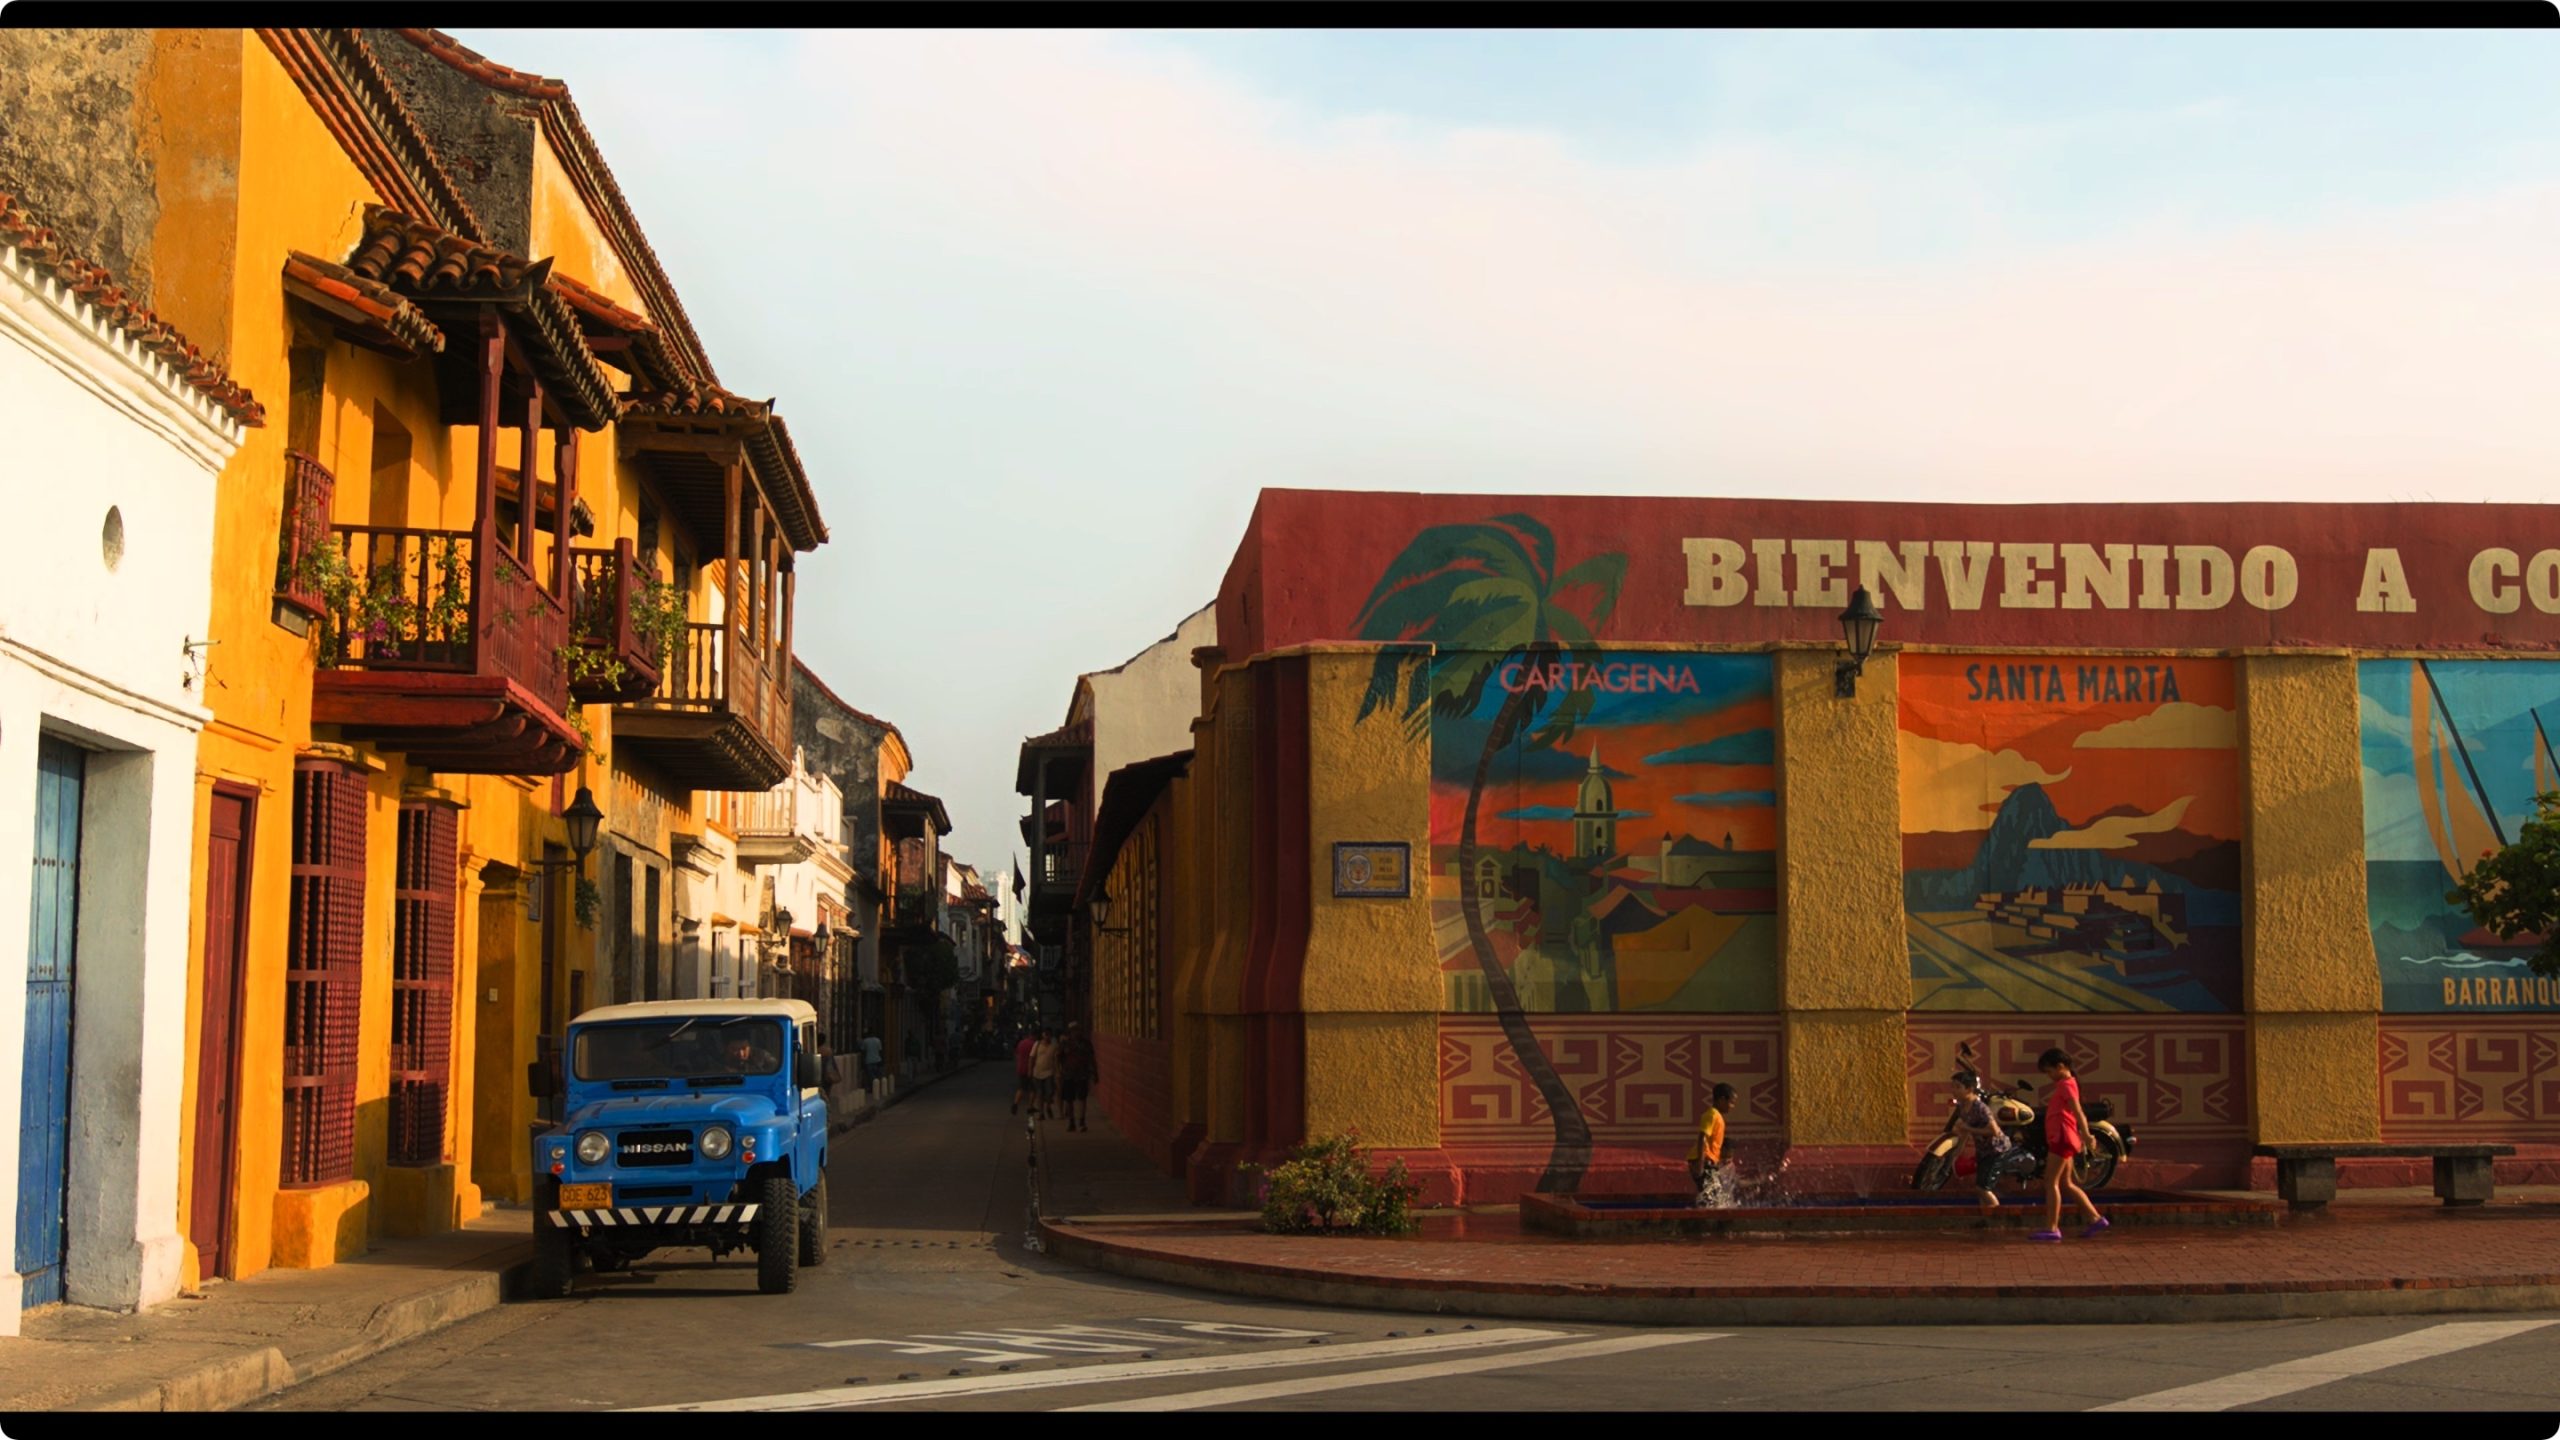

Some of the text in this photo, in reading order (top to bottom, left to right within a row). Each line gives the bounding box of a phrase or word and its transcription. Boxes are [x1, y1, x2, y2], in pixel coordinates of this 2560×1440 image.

[1683, 538, 2299, 611] BIENVENIDO
[2356, 548, 2417, 613] A
[1501, 663, 1699, 694] CARTAGENA
[1967, 664, 2181, 703] SANTA MARTA
[623, 1143, 688, 1154] NISSAN
